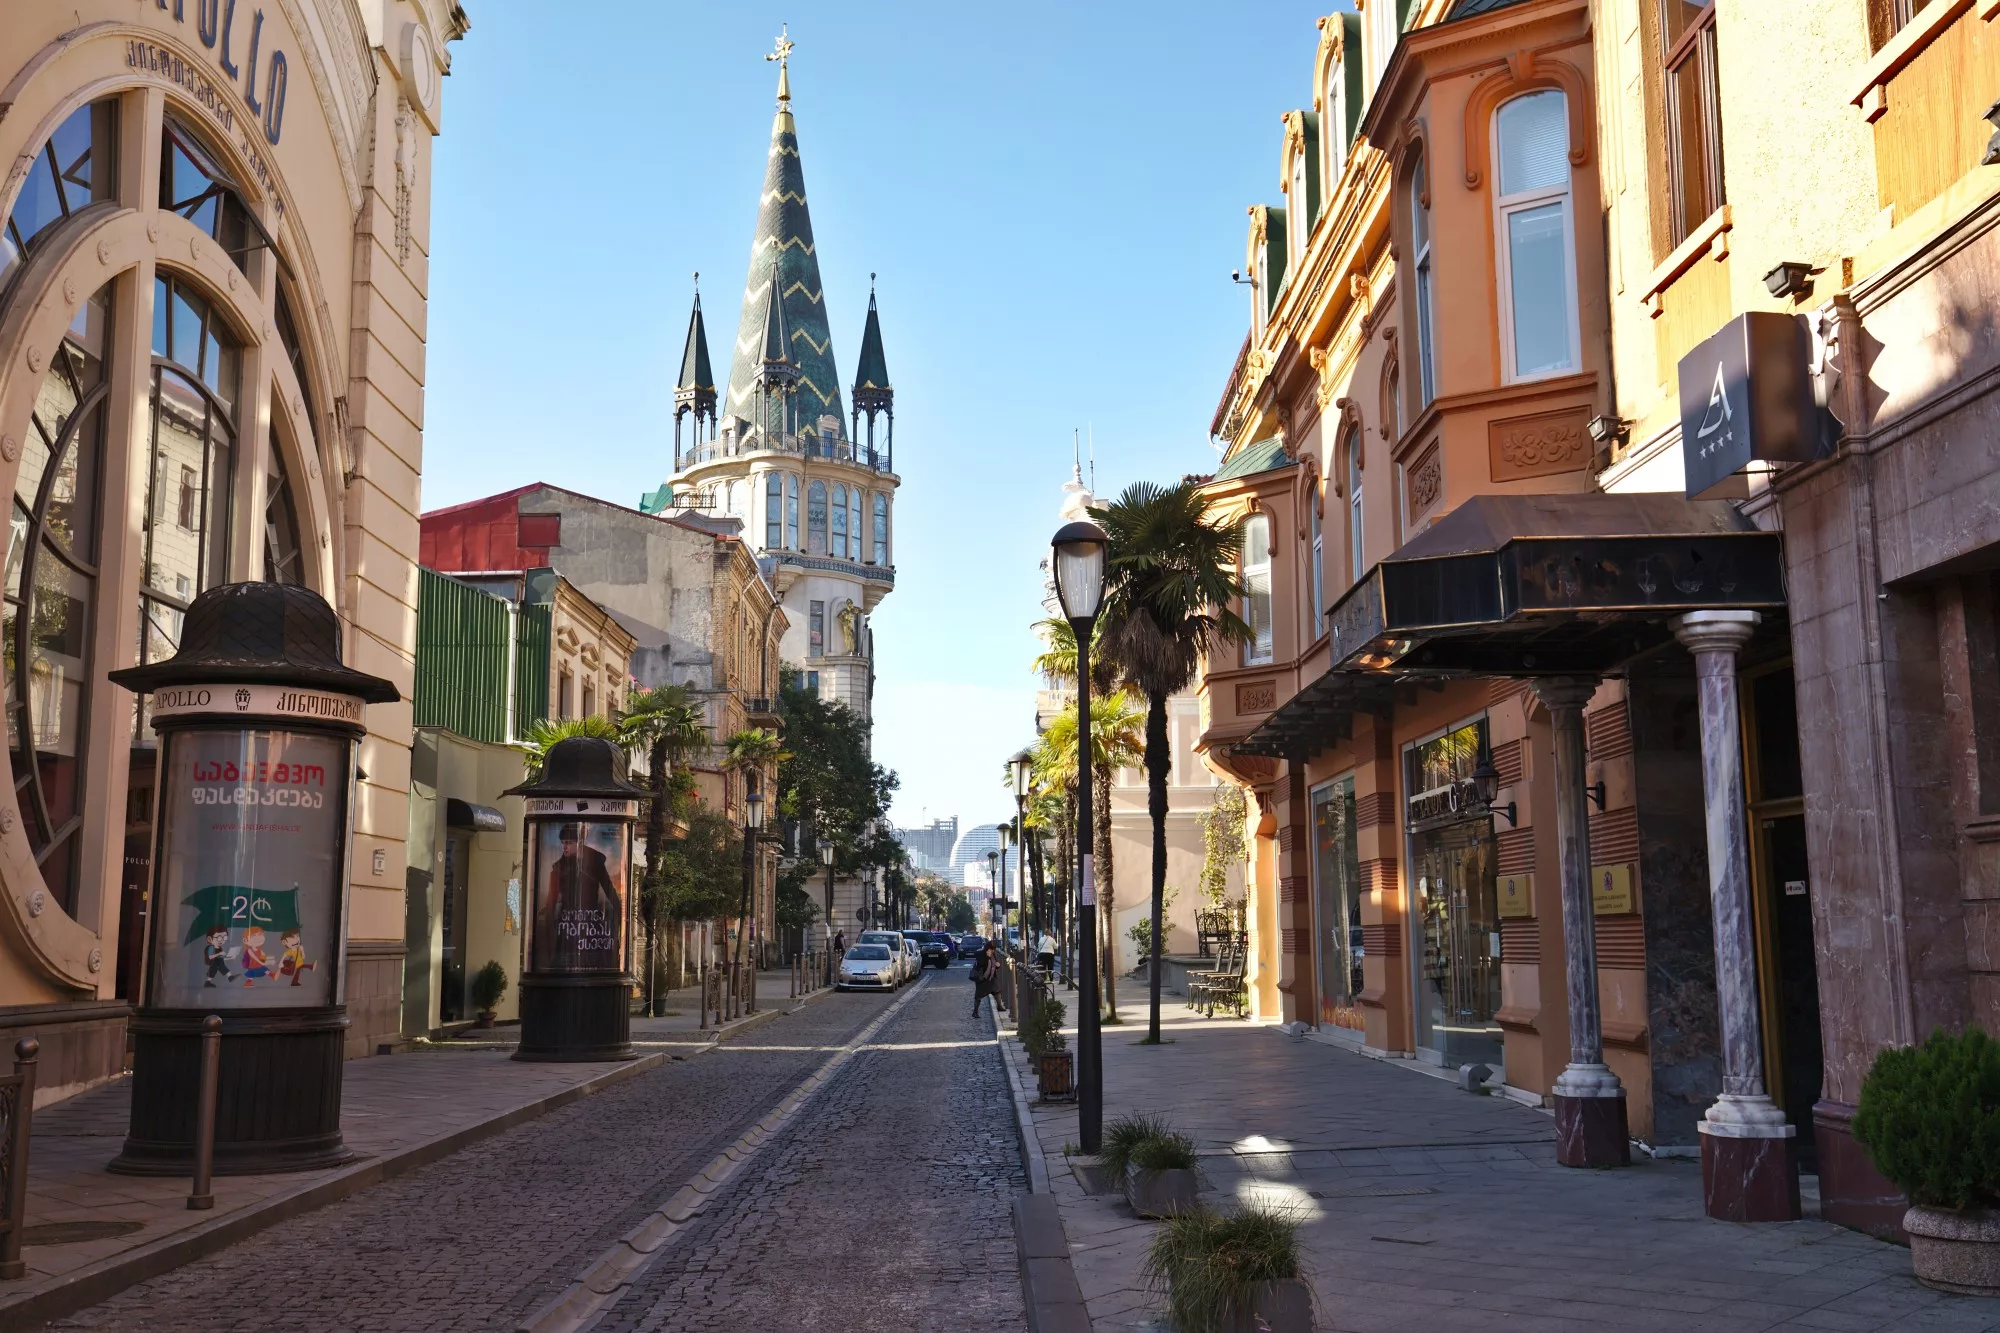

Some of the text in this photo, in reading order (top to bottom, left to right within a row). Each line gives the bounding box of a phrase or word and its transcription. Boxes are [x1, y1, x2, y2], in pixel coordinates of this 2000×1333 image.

[158, 0, 287, 145] OLLO
[155, 690, 211, 710] APOLLO
[277, 692, 361, 722] კინოთეატრი
[193, 761, 325, 787] საბავშვო
[192, 787, 323, 809] ფასდაკლება
